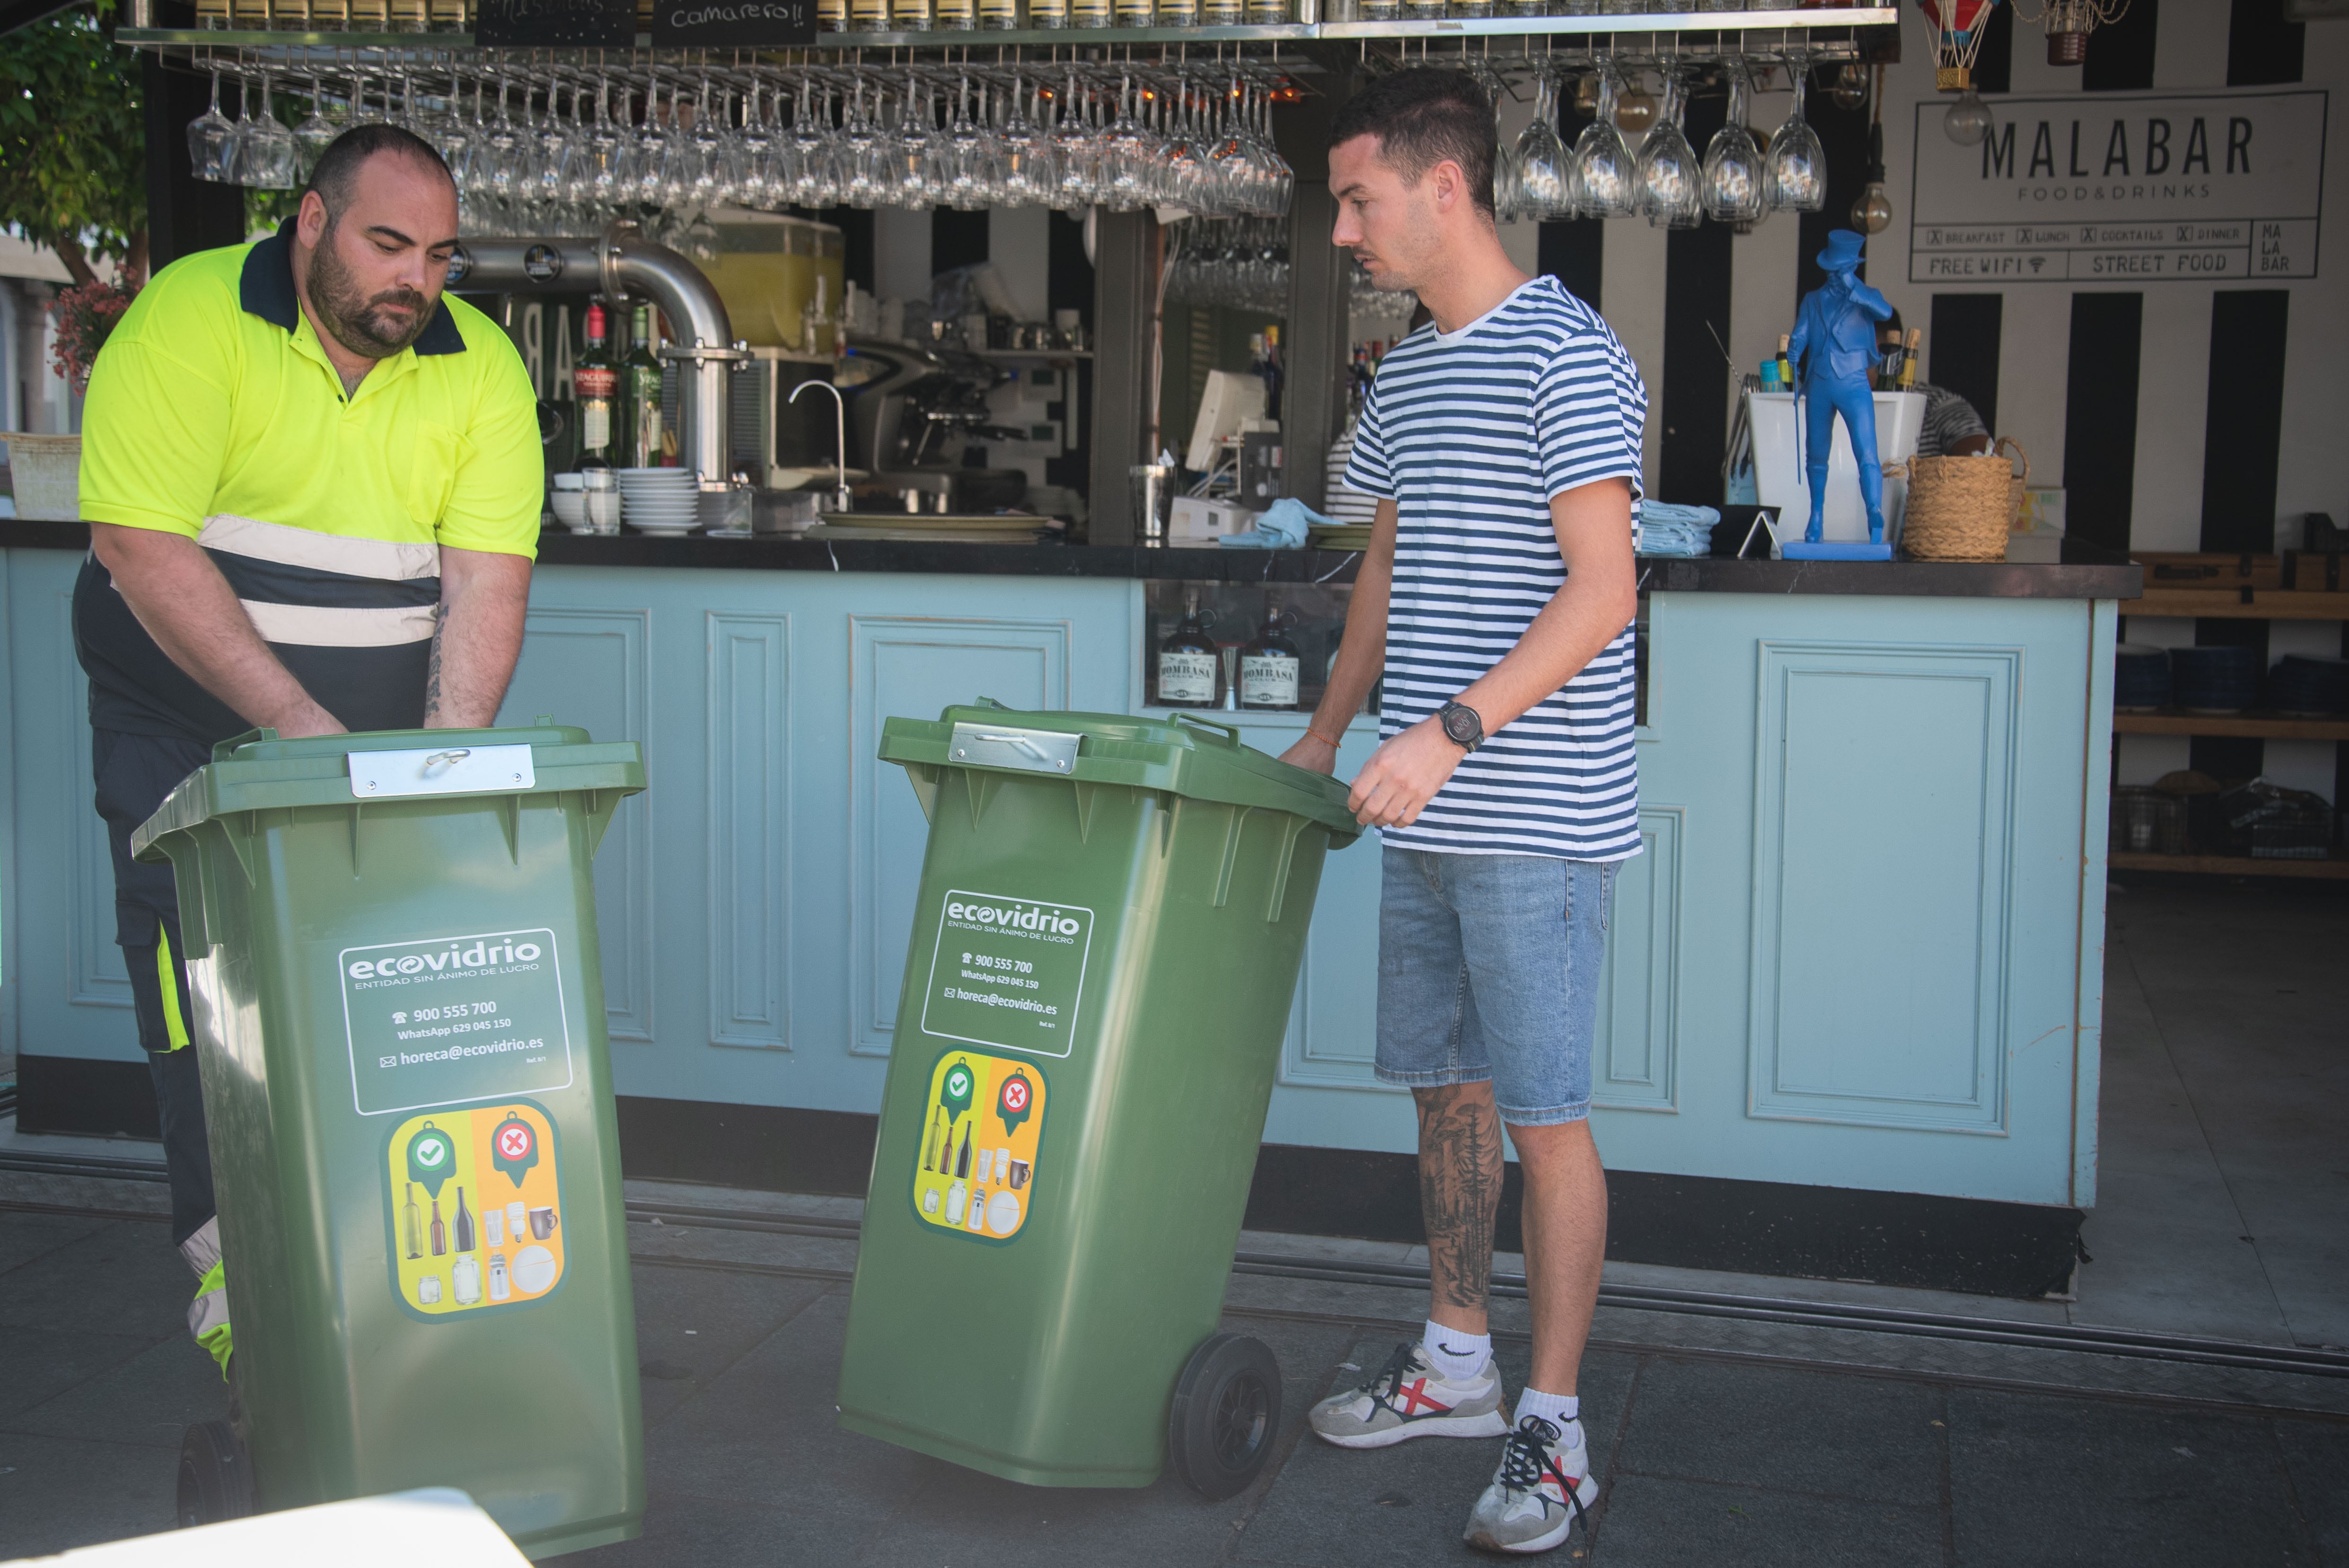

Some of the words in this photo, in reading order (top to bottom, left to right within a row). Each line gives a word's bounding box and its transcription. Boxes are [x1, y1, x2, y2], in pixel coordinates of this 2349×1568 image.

[671, 3, 804, 27] camarero!!
[1981, 117, 2253, 179] MALABAR
[2018, 184, 2210, 201] FOOD&DRINKS
[1945, 232, 2005, 244] BREAKFAST
[2035, 231, 2069, 243] LUNCH
[2101, 230, 2164, 242] COCKTAILS
[2198, 228, 2240, 240] DINNER
[2262, 224, 2280, 239] MA
[2261, 240, 2280, 255] LA
[1930, 258, 1973, 275] FREE
[1980, 257, 2022, 274] WIFI
[2093, 254, 2165, 273] STREET
[2177, 254, 2226, 272] FOOD
[2261, 256, 2289, 272] BAR
[1161, 665, 1210, 679] MOMBASA
[1243, 668, 1293, 682] MOMBASA
[947, 902, 1080, 936] ecovidrio
[947, 920, 982, 931] ENTIDAD
[999, 927, 1027, 938] ÁNIMO
[1043, 934, 1074, 945] LUCRO
[349, 937, 541, 980] ecovidrio
[975, 955, 993, 968] 900
[994, 957, 1012, 971] 555
[1014, 960, 1033, 973] 700
[355, 977, 411, 990] ENTIDAD
[413, 974, 434, 983] SIN
[437, 969, 477, 981] ÁNIMO
[480, 968, 497, 976] DE
[500, 964, 539, 973] LUCRO
[961, 969, 996, 984] WhatsApp
[996, 975, 1009, 984] 629
[1010, 977, 1024, 987] 045
[1025, 979, 1039, 990] 150
[956, 988, 1058, 1016] horeca@ecovidrio.es
[413, 1007, 440, 1022] 900
[443, 1004, 469, 1019] 555
[472, 1001, 497, 1016] 700
[397, 1026, 451, 1041] WhatsApp
[453, 1023, 472, 1034] 629
[473, 1020, 491, 1031] 045
[493, 1017, 511, 1029] 150
[400, 1037, 543, 1065] horeca@ecovidrio.es
